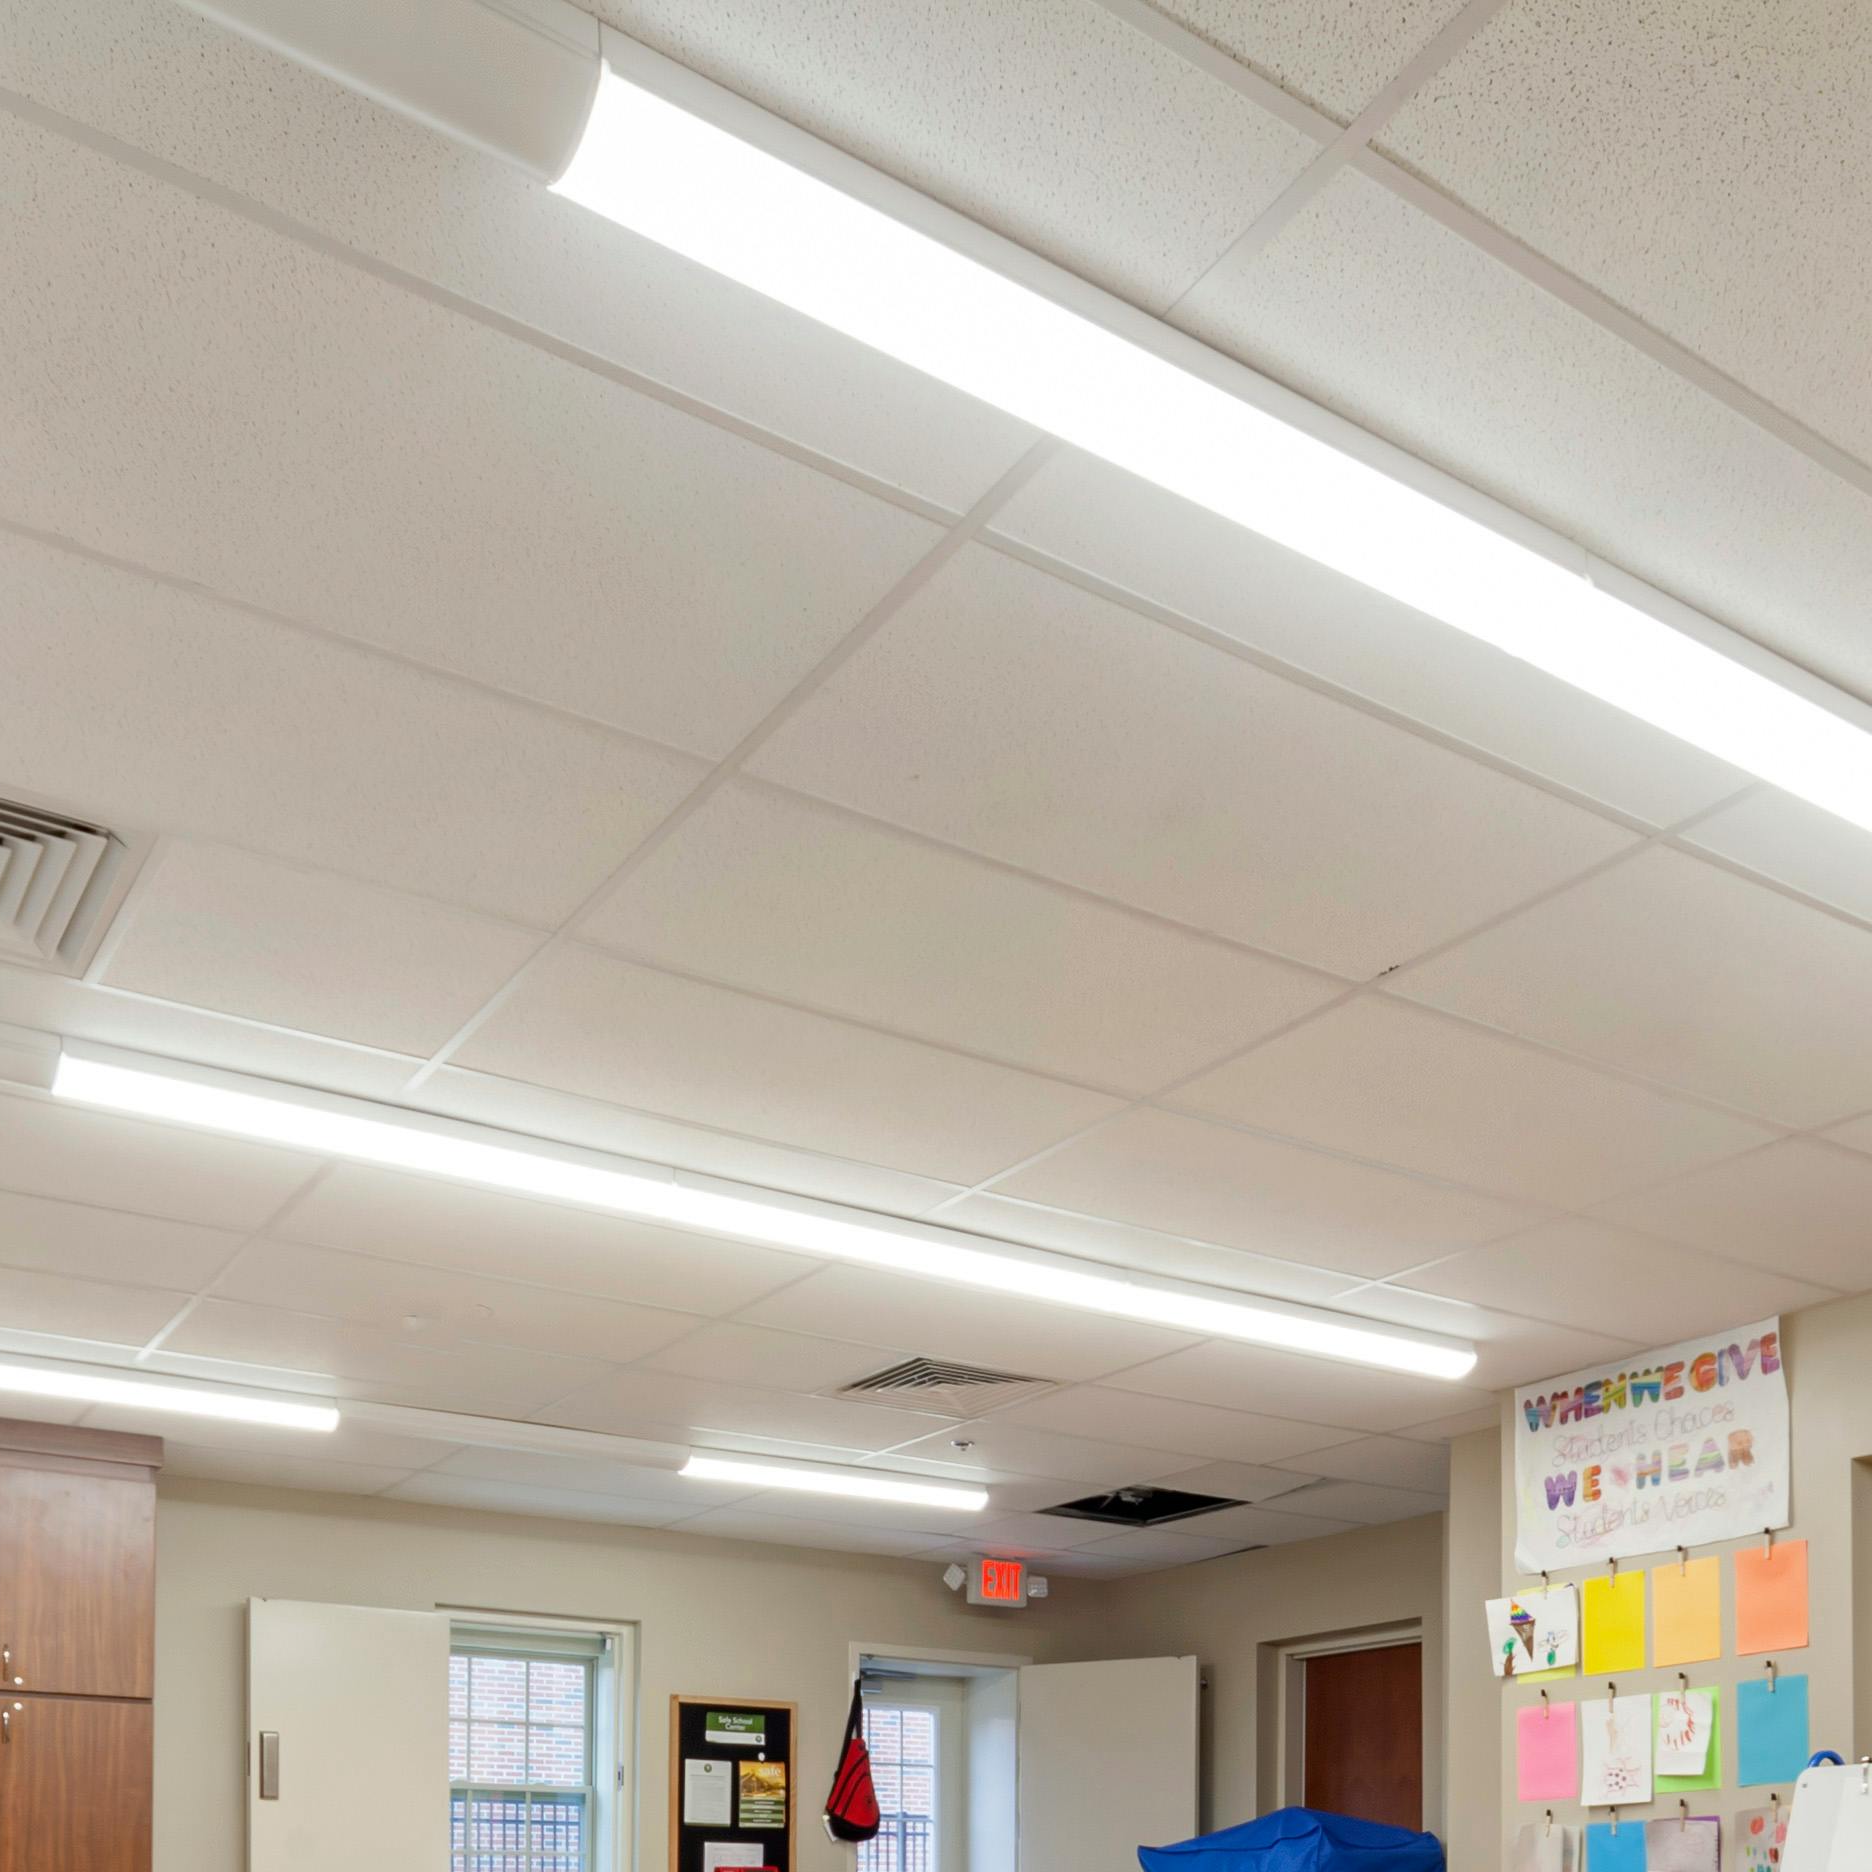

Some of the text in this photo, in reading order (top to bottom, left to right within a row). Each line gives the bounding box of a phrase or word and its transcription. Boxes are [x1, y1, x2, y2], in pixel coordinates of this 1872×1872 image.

[1524, 1332, 1781, 1432] WHEN WE GIVE
[1544, 1429, 1755, 1511] WE HEAR
[981, 1559, 1022, 1600] EXIT
